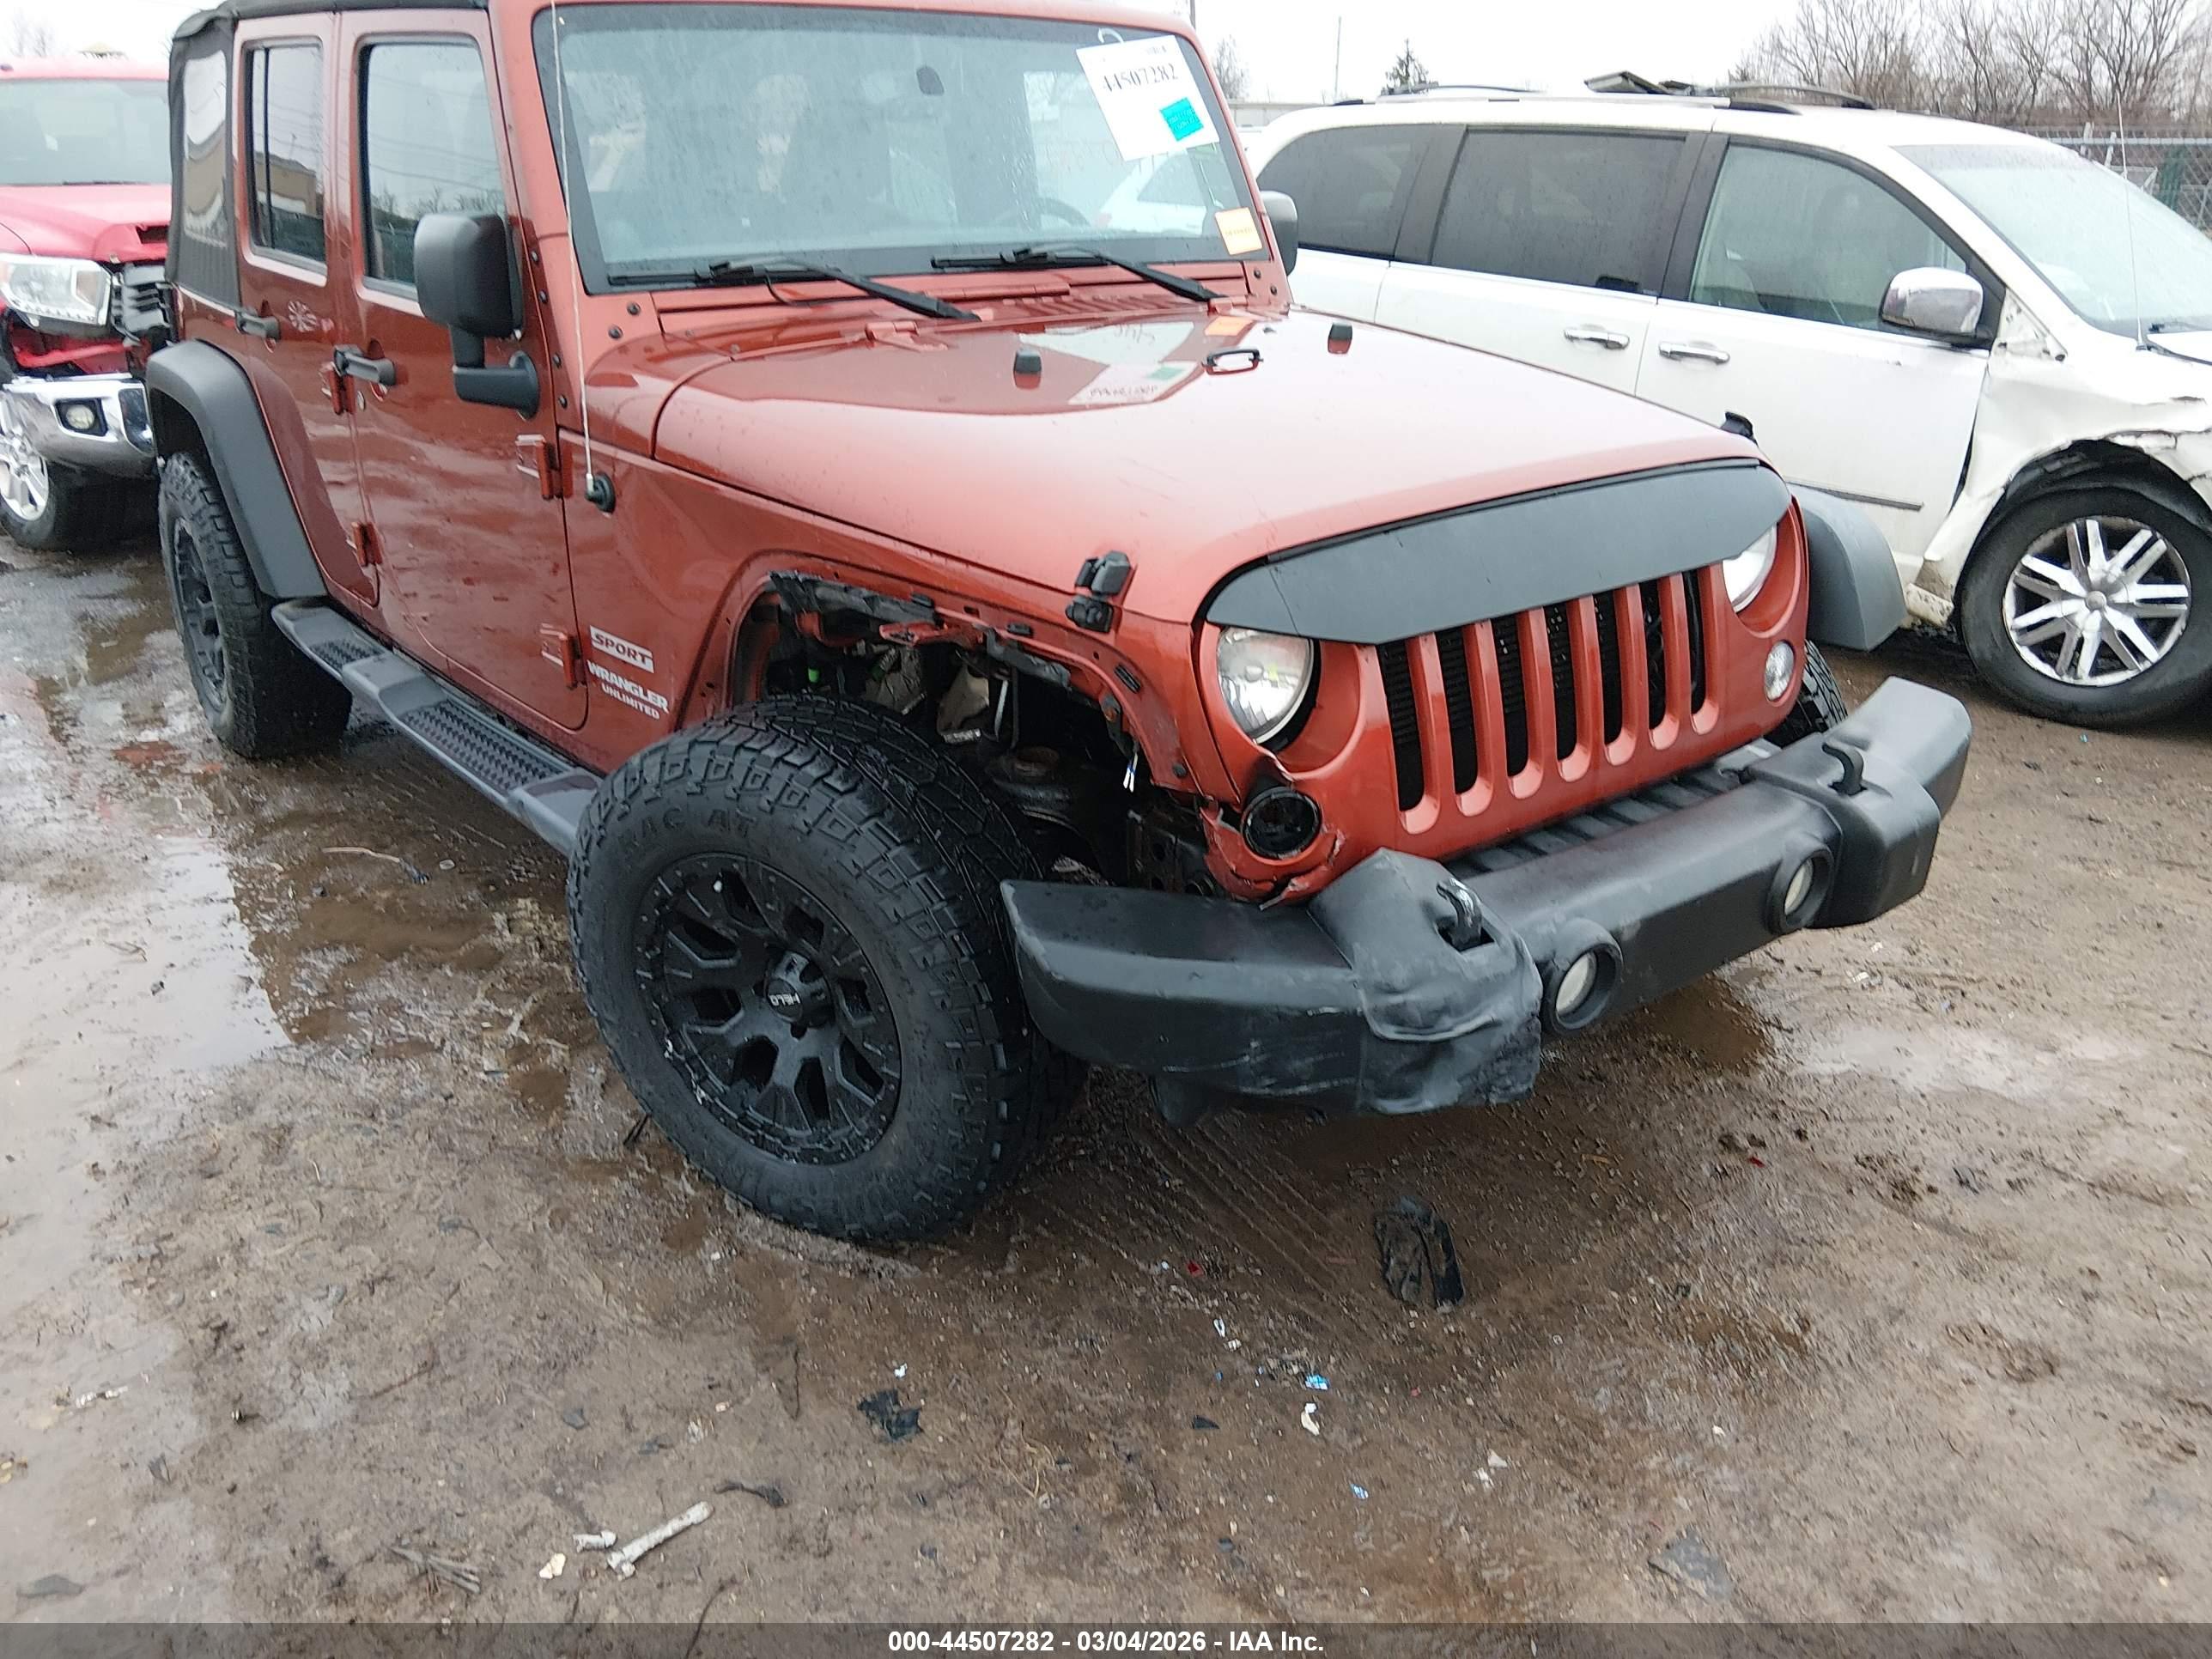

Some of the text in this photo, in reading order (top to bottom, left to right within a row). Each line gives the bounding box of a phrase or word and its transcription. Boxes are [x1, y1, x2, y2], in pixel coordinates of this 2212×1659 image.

[593, 632, 650, 665] SPORT
[586, 659, 669, 714] WRANGLER
[601, 683, 660, 720] UNLIMITED
